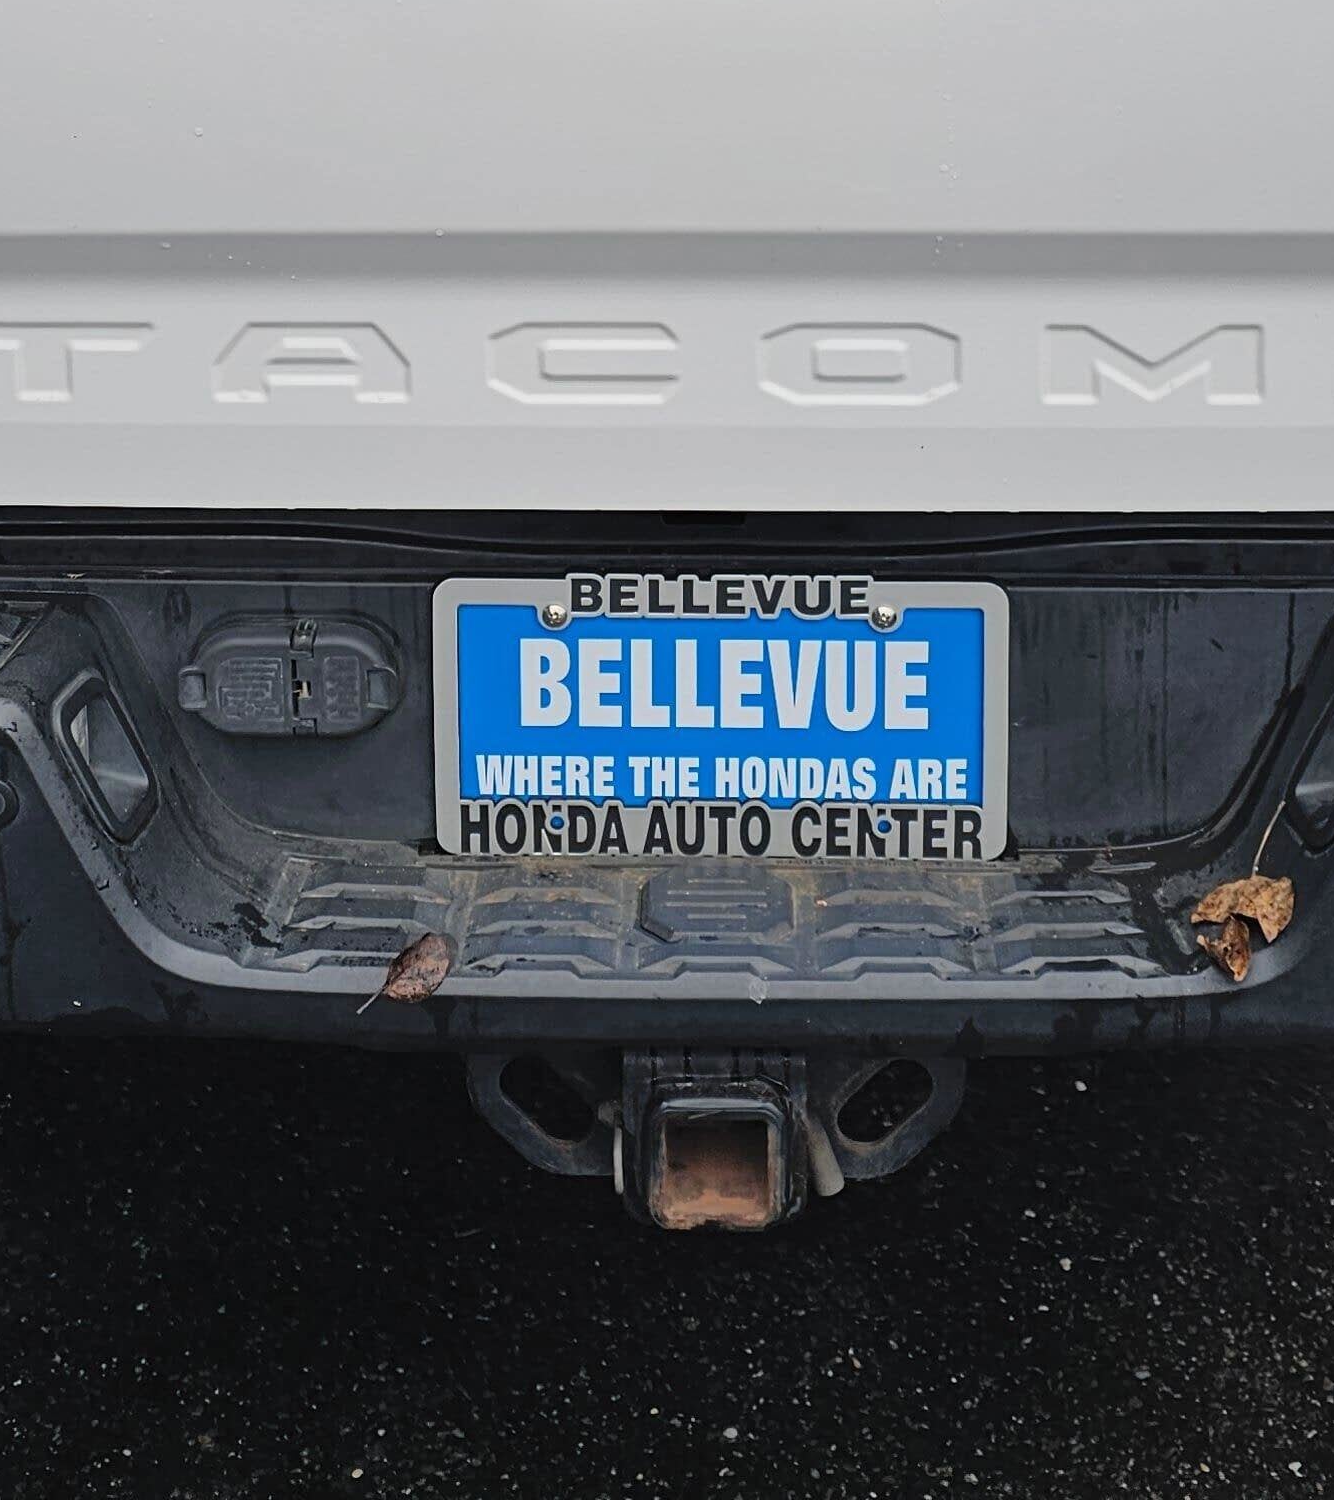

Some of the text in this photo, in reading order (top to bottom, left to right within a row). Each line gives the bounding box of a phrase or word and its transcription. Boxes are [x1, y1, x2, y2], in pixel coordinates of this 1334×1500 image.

[570, 578, 869, 617] BELLEVUE
[519, 637, 930, 732] BELLEVUE
[475, 755, 967, 800] WHERE THE HONDAS ARE
[460, 804, 982, 860] HONDA AUTO CENTER
